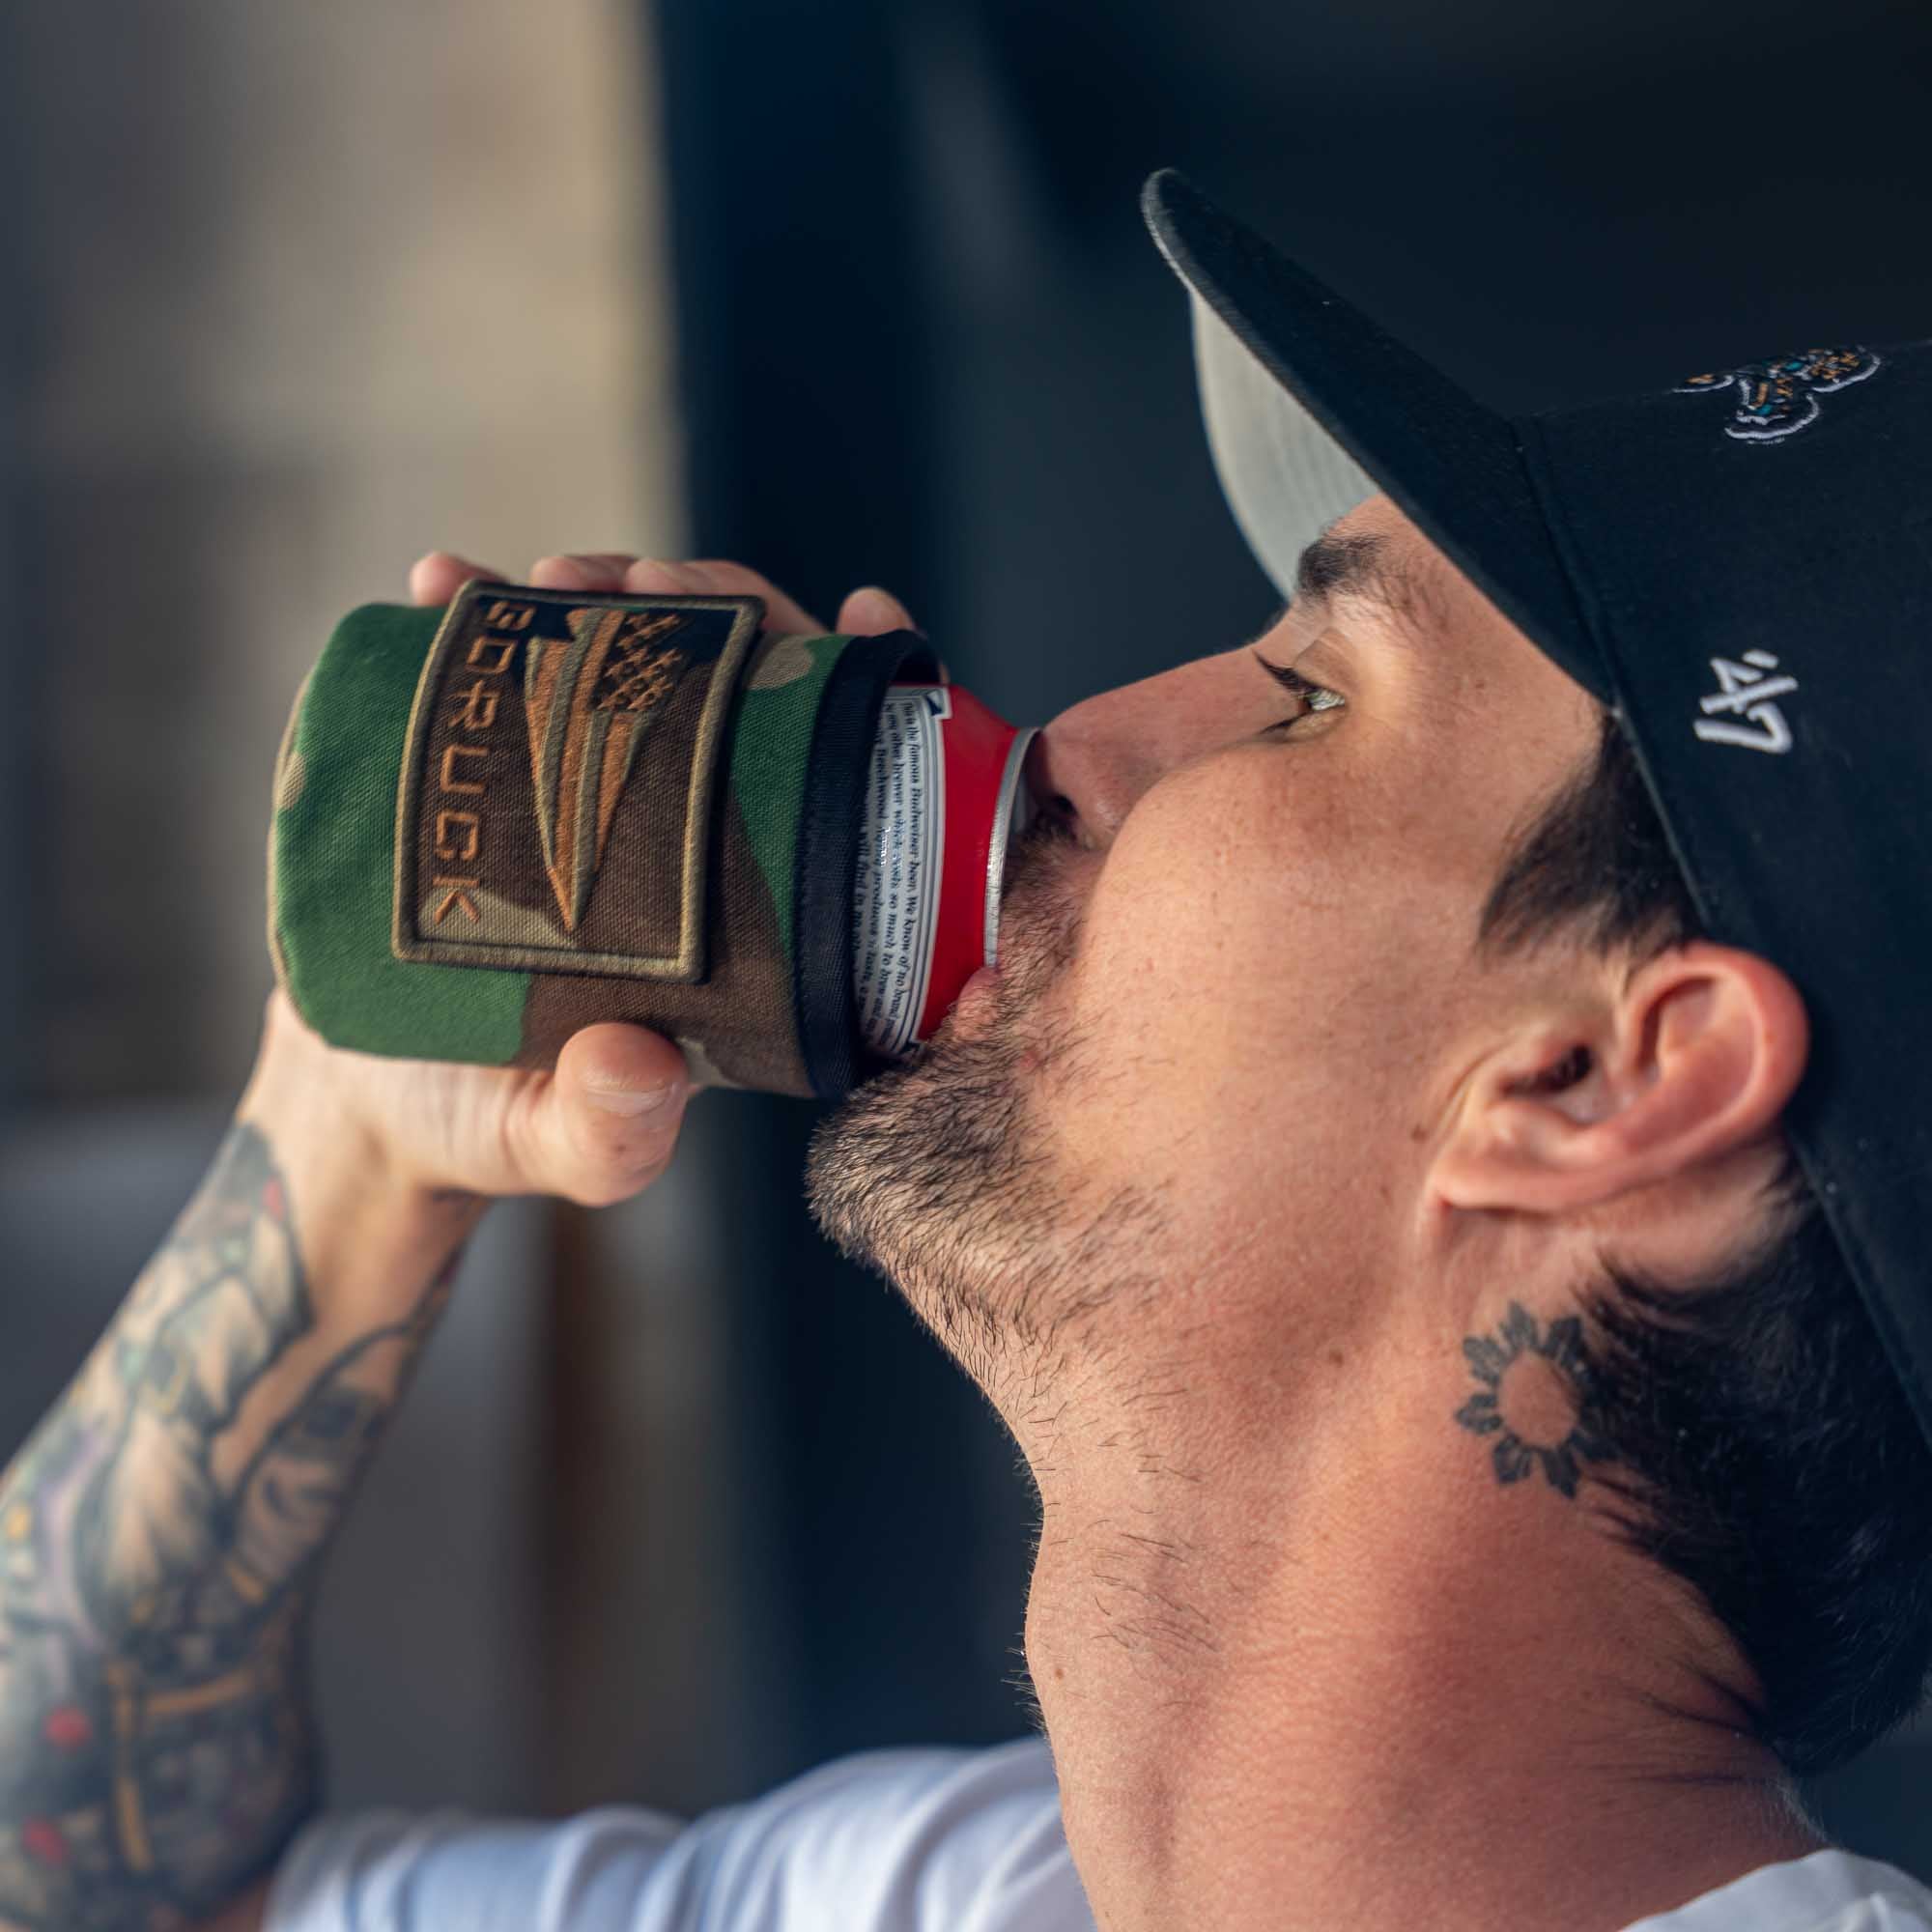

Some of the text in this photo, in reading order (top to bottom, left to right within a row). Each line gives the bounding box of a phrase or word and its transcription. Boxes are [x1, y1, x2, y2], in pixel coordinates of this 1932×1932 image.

[891, 732, 906, 758] other
[906, 726, 921, 742] the
[432, 600, 538, 927] GORUCK
[907, 743, 922, 784] famous
[875, 749, 890, 820] Beechwood
[893, 763, 906, 806] brewer
[909, 787, 923, 859] Budweiser
[870, 870, 887, 938] produces
[888, 893, 899, 910] so
[905, 895, 920, 916] We
[883, 913, 899, 949] much
[900, 918, 918, 952] know
[882, 952, 895, 966] to
[896, 955, 912, 972] of
[877, 968, 892, 995] brew
[895, 971, 908, 987] no
[889, 988, 908, 1019] brand
